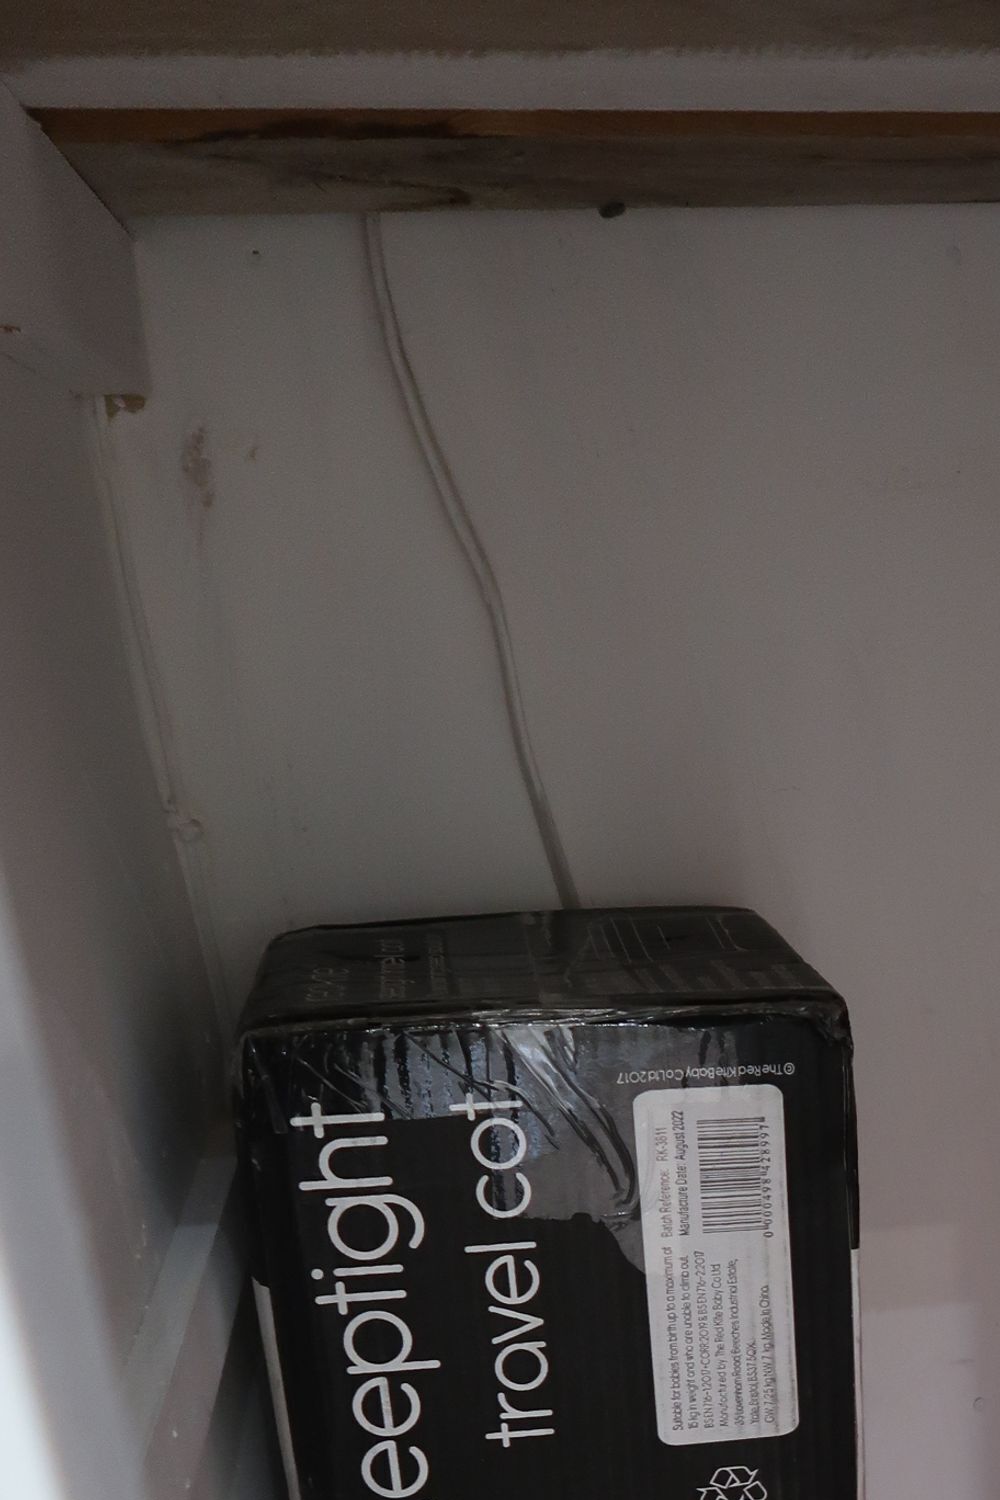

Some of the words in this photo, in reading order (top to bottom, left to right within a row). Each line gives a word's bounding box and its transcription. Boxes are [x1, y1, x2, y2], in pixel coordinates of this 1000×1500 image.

[616, 1071, 646, 1084] 2017
[648, 1070, 665, 1082] Ltd
[667, 1069, 684, 1081] Co
[685, 1066, 715, 1079] Baby
[716, 1067, 736, 1078] Kite
[738, 1065, 761, 1077] Red
[671, 1111, 685, 1131] 2022
[672, 1132, 687, 1160] August
[449, 1091, 533, 1219] cot
[675, 1163, 687, 1184] Date:
[676, 1186, 689, 1236] Manufacture
[662, 1214, 672, 1237] Batch
[711, 1277, 721, 1288] Co
[666, 1303, 675, 1311] to
[712, 1290, 724, 1310] Baby
[682, 1302, 692, 1328] unable
[713, 1312, 723, 1326] Kite
[684, 1330, 693, 1344] are
[714, 1327, 724, 1342] Red
[463, 1240, 556, 1448] travel
[668, 1343, 679, 1361] from
[685, 1346, 693, 1361] who
[686, 1362, 695, 1377] and
[718, 1360, 728, 1369] by
[670, 1362, 680, 1388] babies
[671, 1391, 680, 1400] for
[687, 1379, 698, 1403] weight
[717, 1372, 728, 1426] Manufactured
[672, 1402, 683, 1430] Suitable
